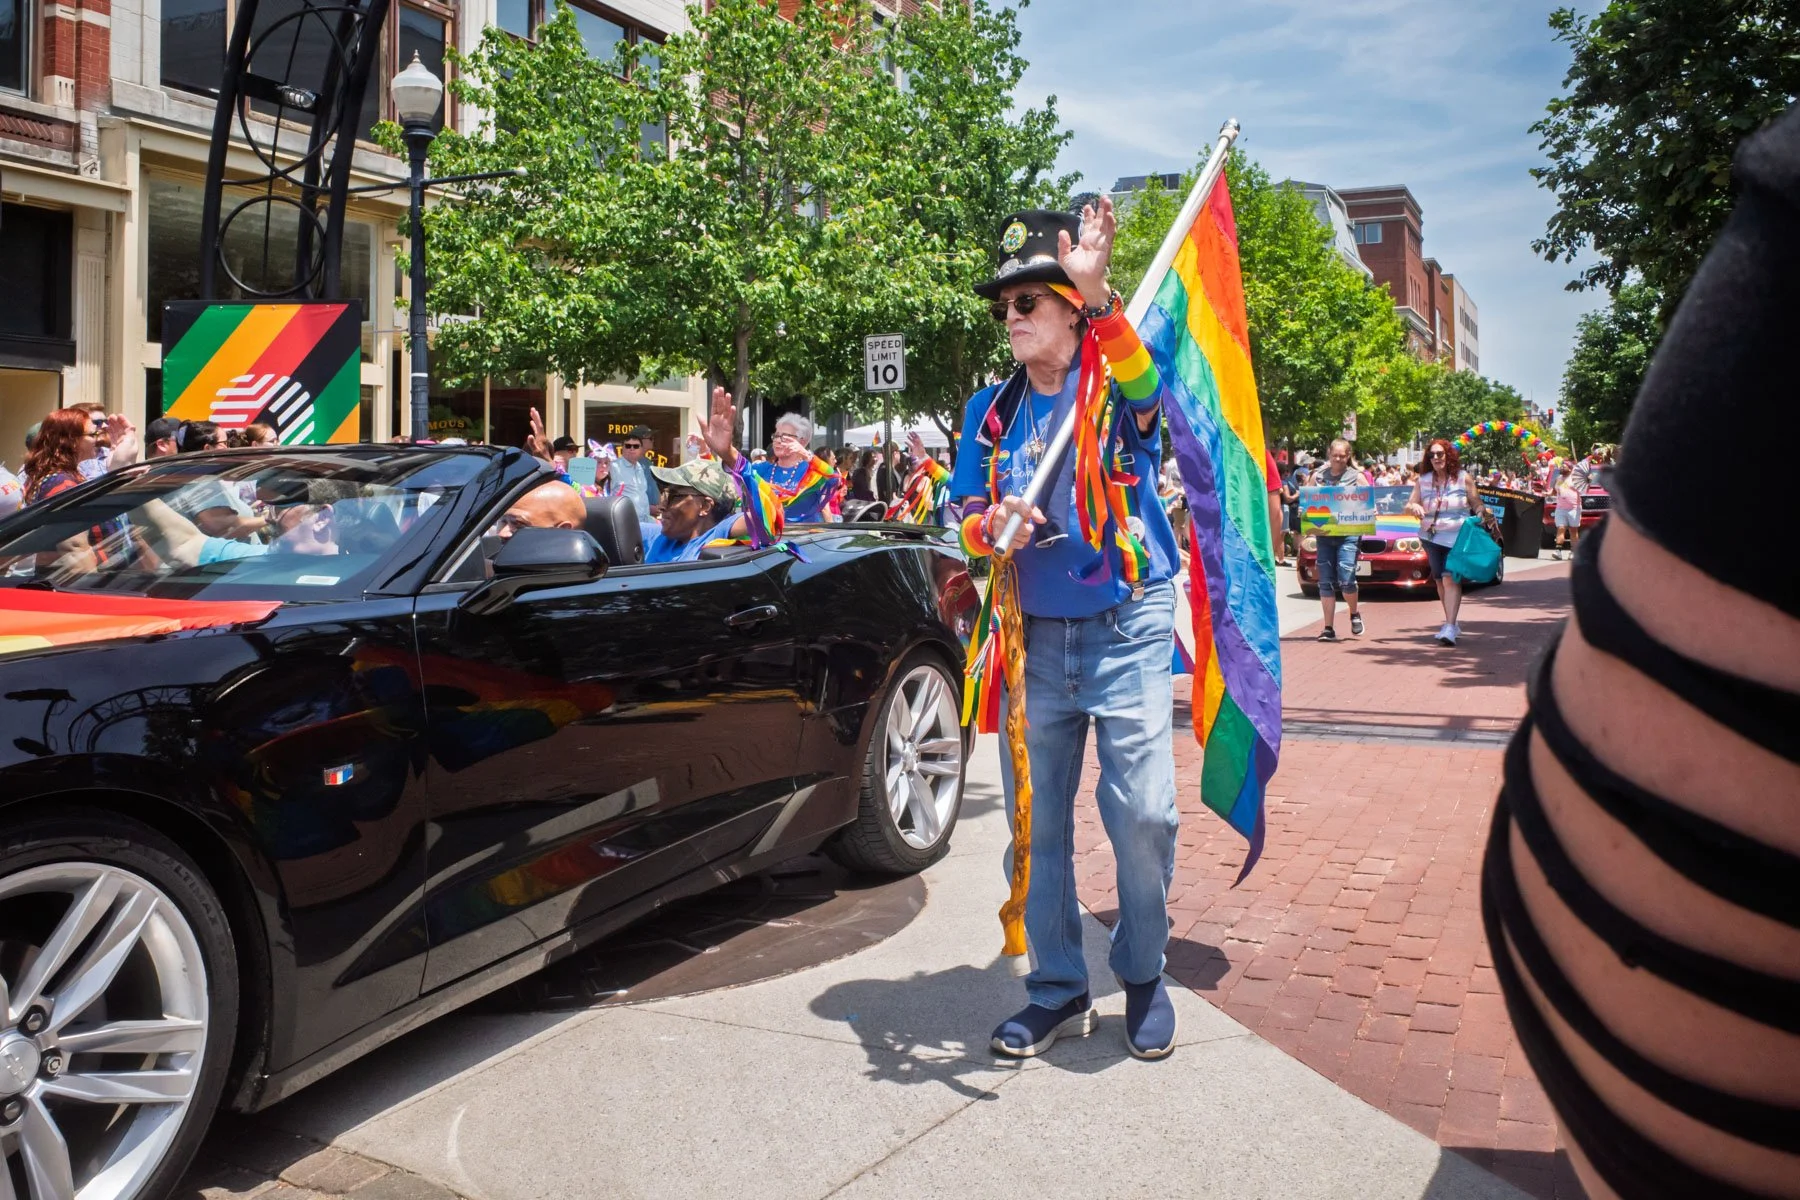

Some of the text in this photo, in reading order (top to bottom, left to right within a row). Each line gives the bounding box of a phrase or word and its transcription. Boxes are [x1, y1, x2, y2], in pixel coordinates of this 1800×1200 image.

[867, 340, 901, 350] SPEED
[871, 352, 897, 361] LIMIT
[872, 363, 898, 385] 10
[427, 419, 465, 431] MOUS
[1312, 493, 1330, 501] am
[1337, 512, 1373, 524] fresh air
